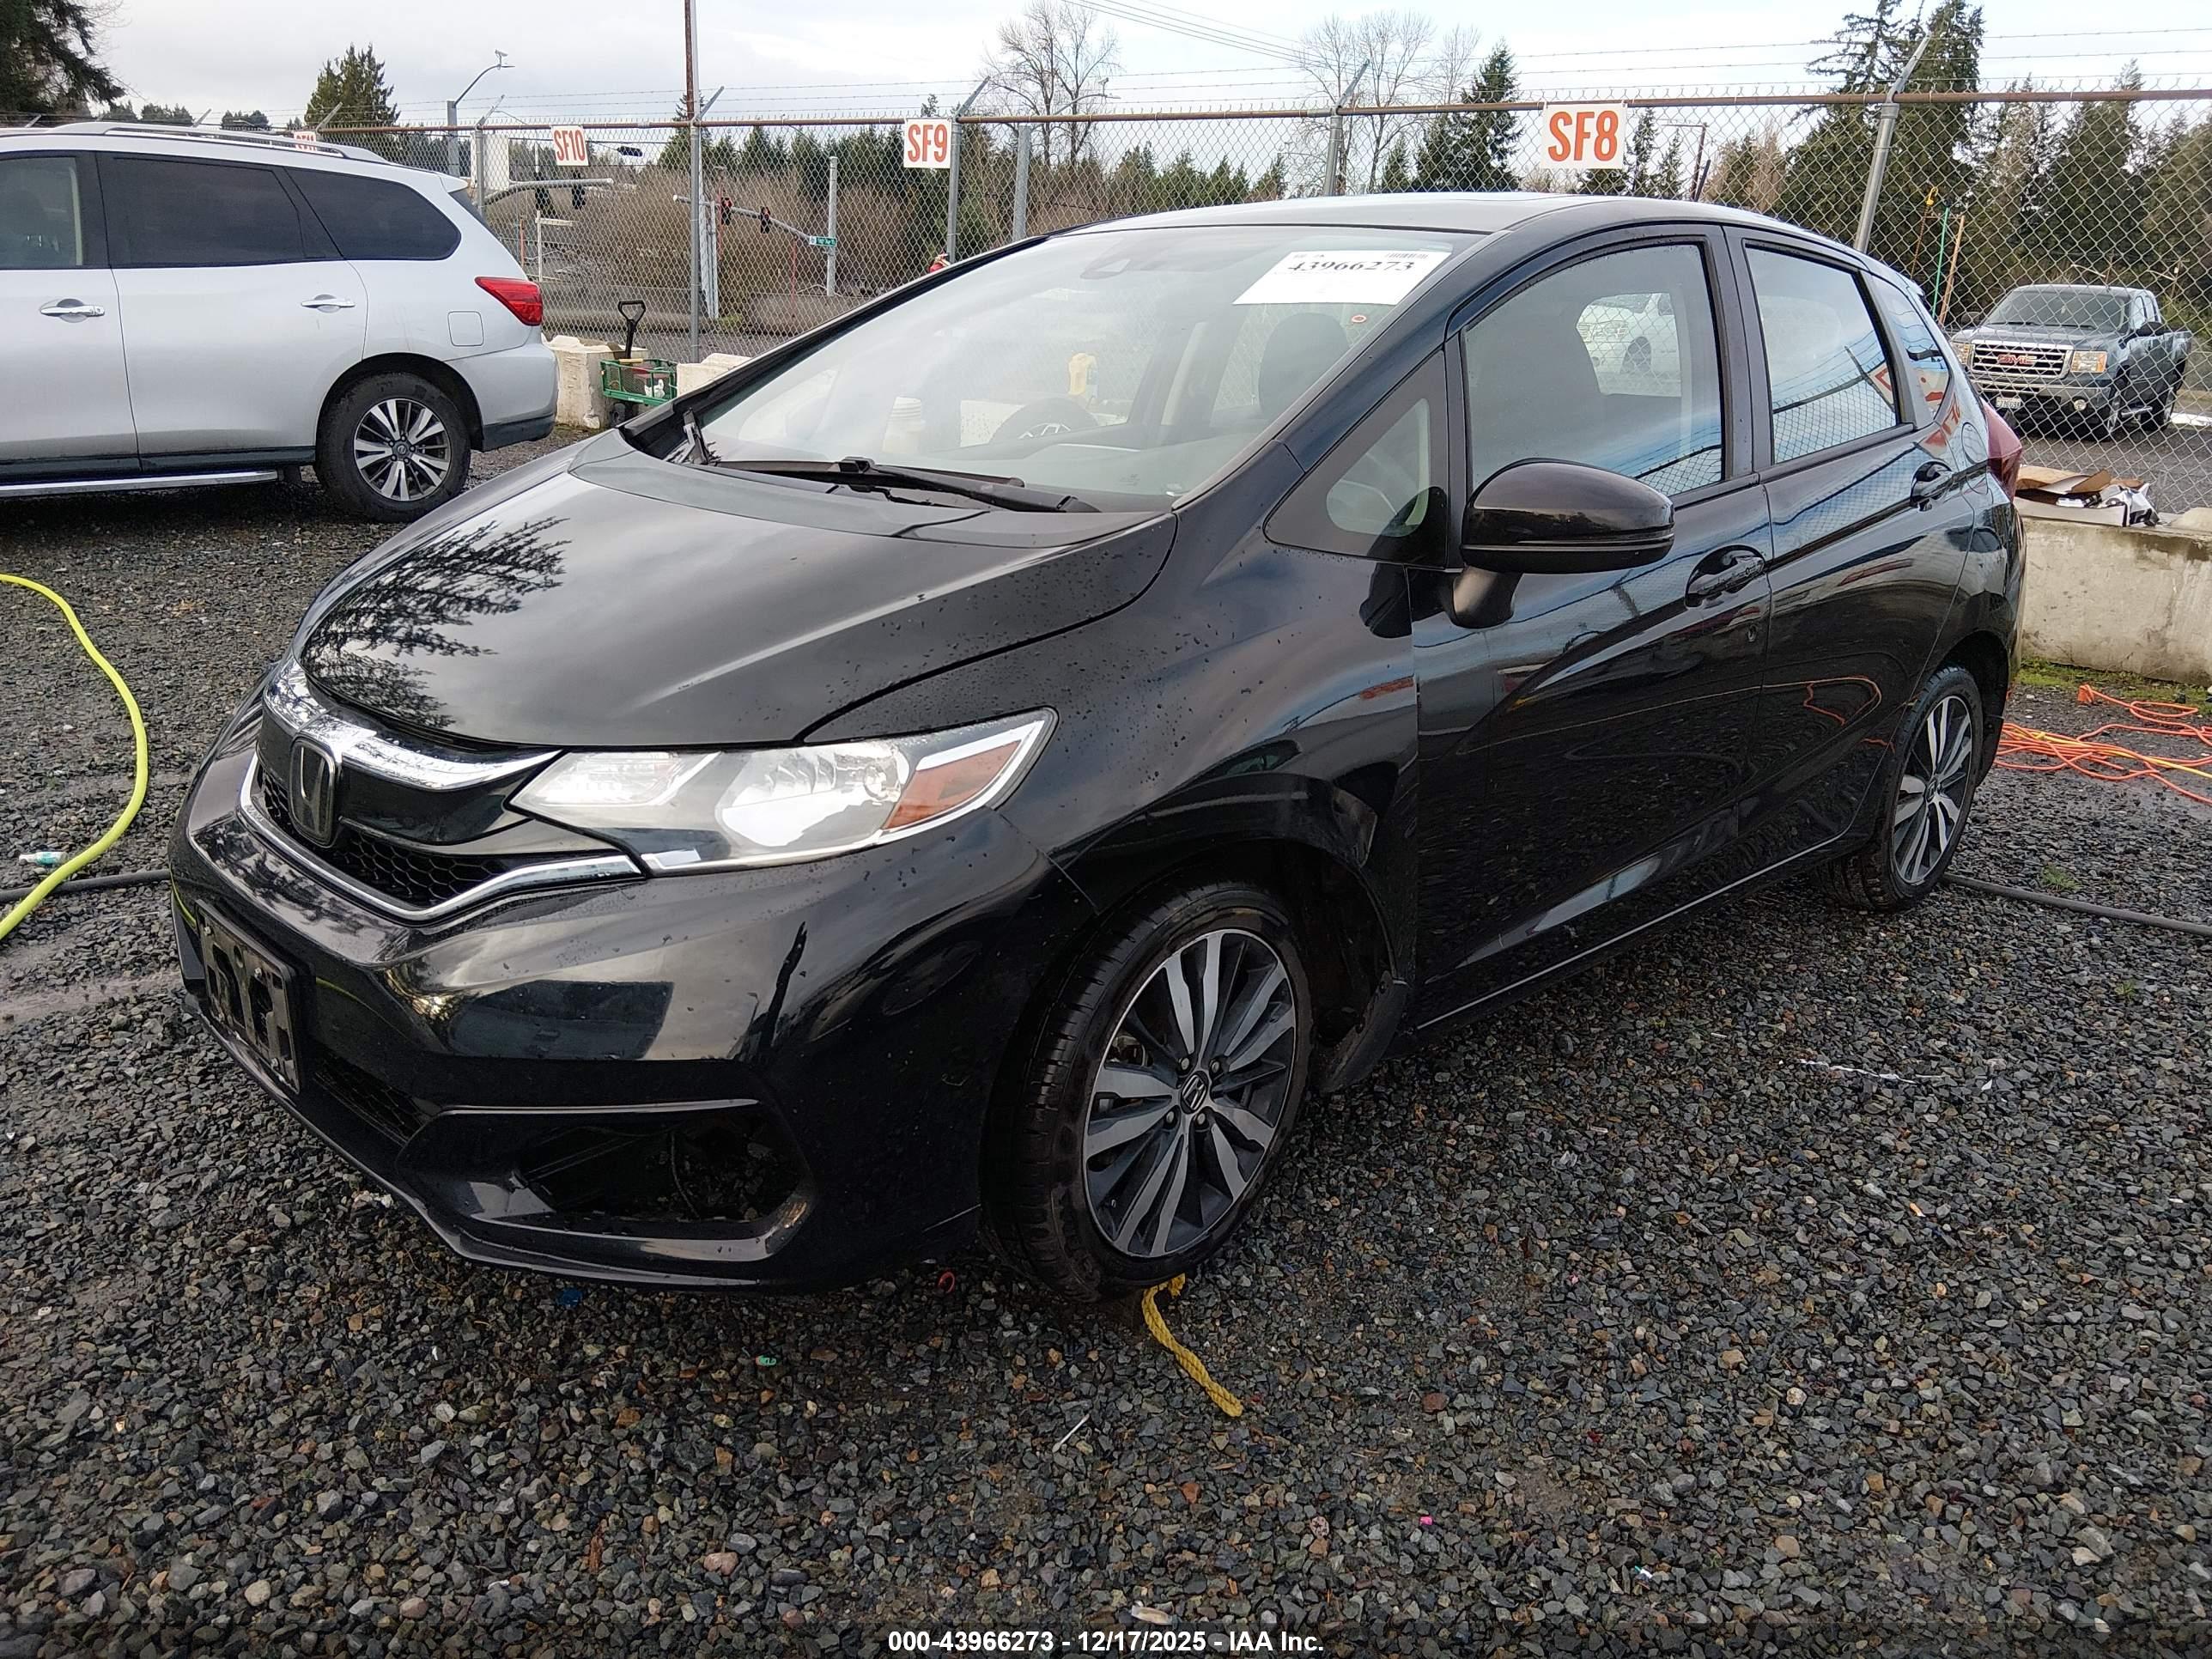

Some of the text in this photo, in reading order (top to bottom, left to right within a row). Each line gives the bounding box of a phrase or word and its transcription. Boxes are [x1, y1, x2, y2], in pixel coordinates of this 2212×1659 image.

[554, 130, 586, 161] SF10
[907, 124, 948, 163] SF9
[1548, 110, 1619, 162] SF8
[1287, 261, 1415, 271] 43966273
[1997, 354, 2038, 366] GMC
